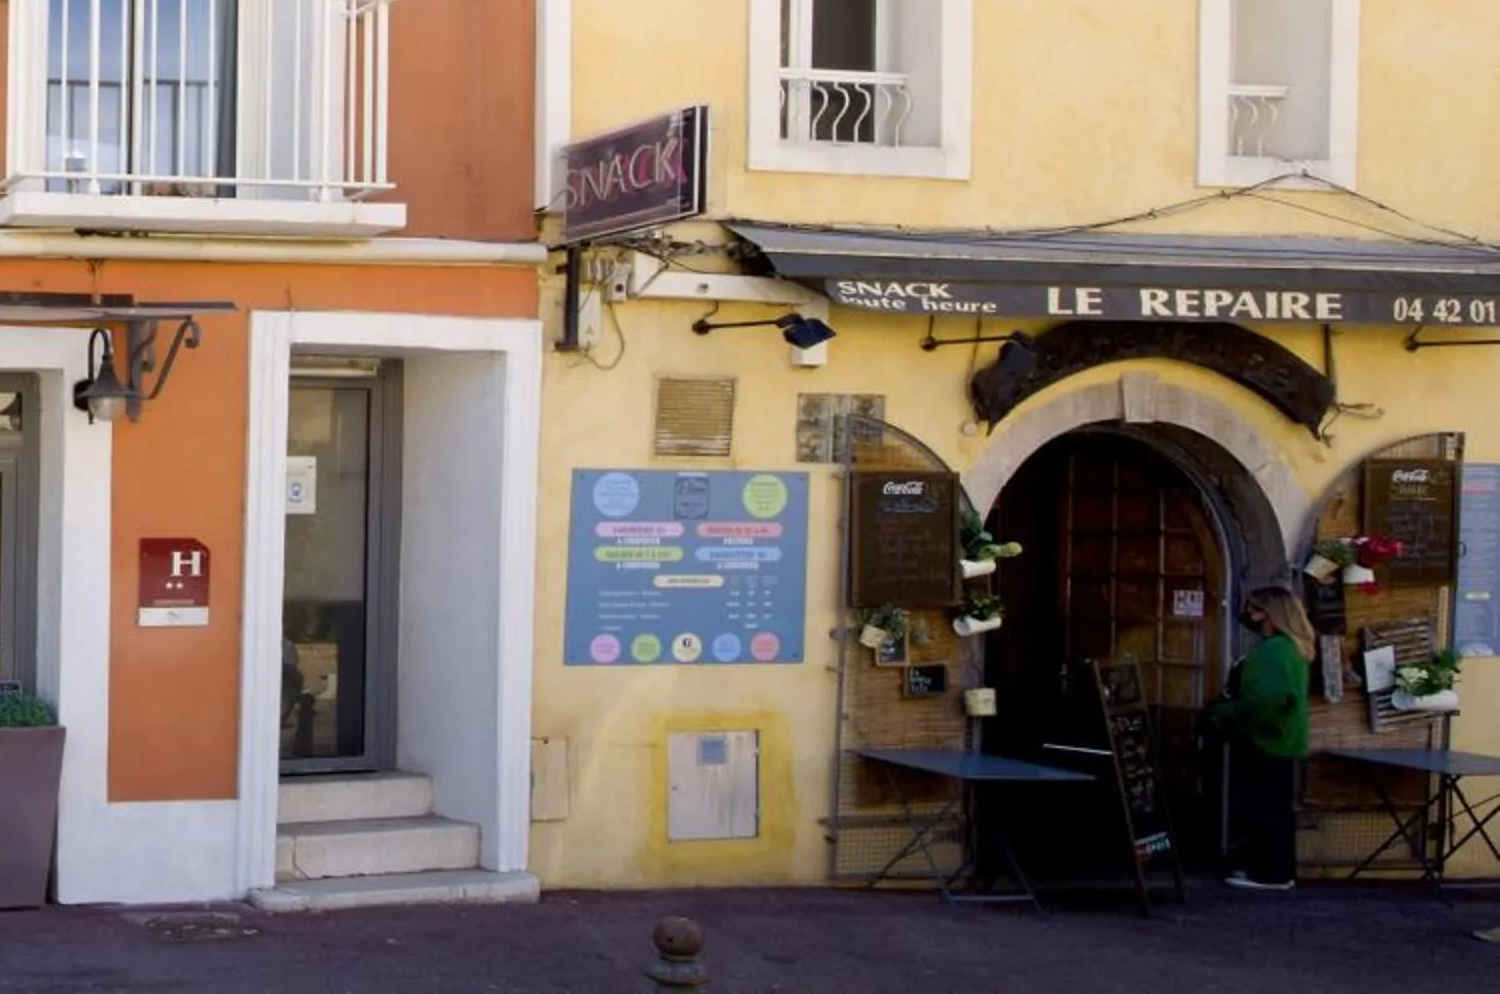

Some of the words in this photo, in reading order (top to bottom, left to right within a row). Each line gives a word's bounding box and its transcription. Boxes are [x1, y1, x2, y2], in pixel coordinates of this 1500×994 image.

[567, 137, 680, 208] SNACK
[837, 281, 953, 299] SNACK
[1047, 287, 1102, 315] LE
[1139, 289, 1343, 319] REPAIRE
[921, 295, 997, 313] heure
[1393, 297, 1425, 322] 04
[1432, 298, 1462, 323] 42
[1469, 299, 1496, 323] 01
[169, 551, 203, 577] H
